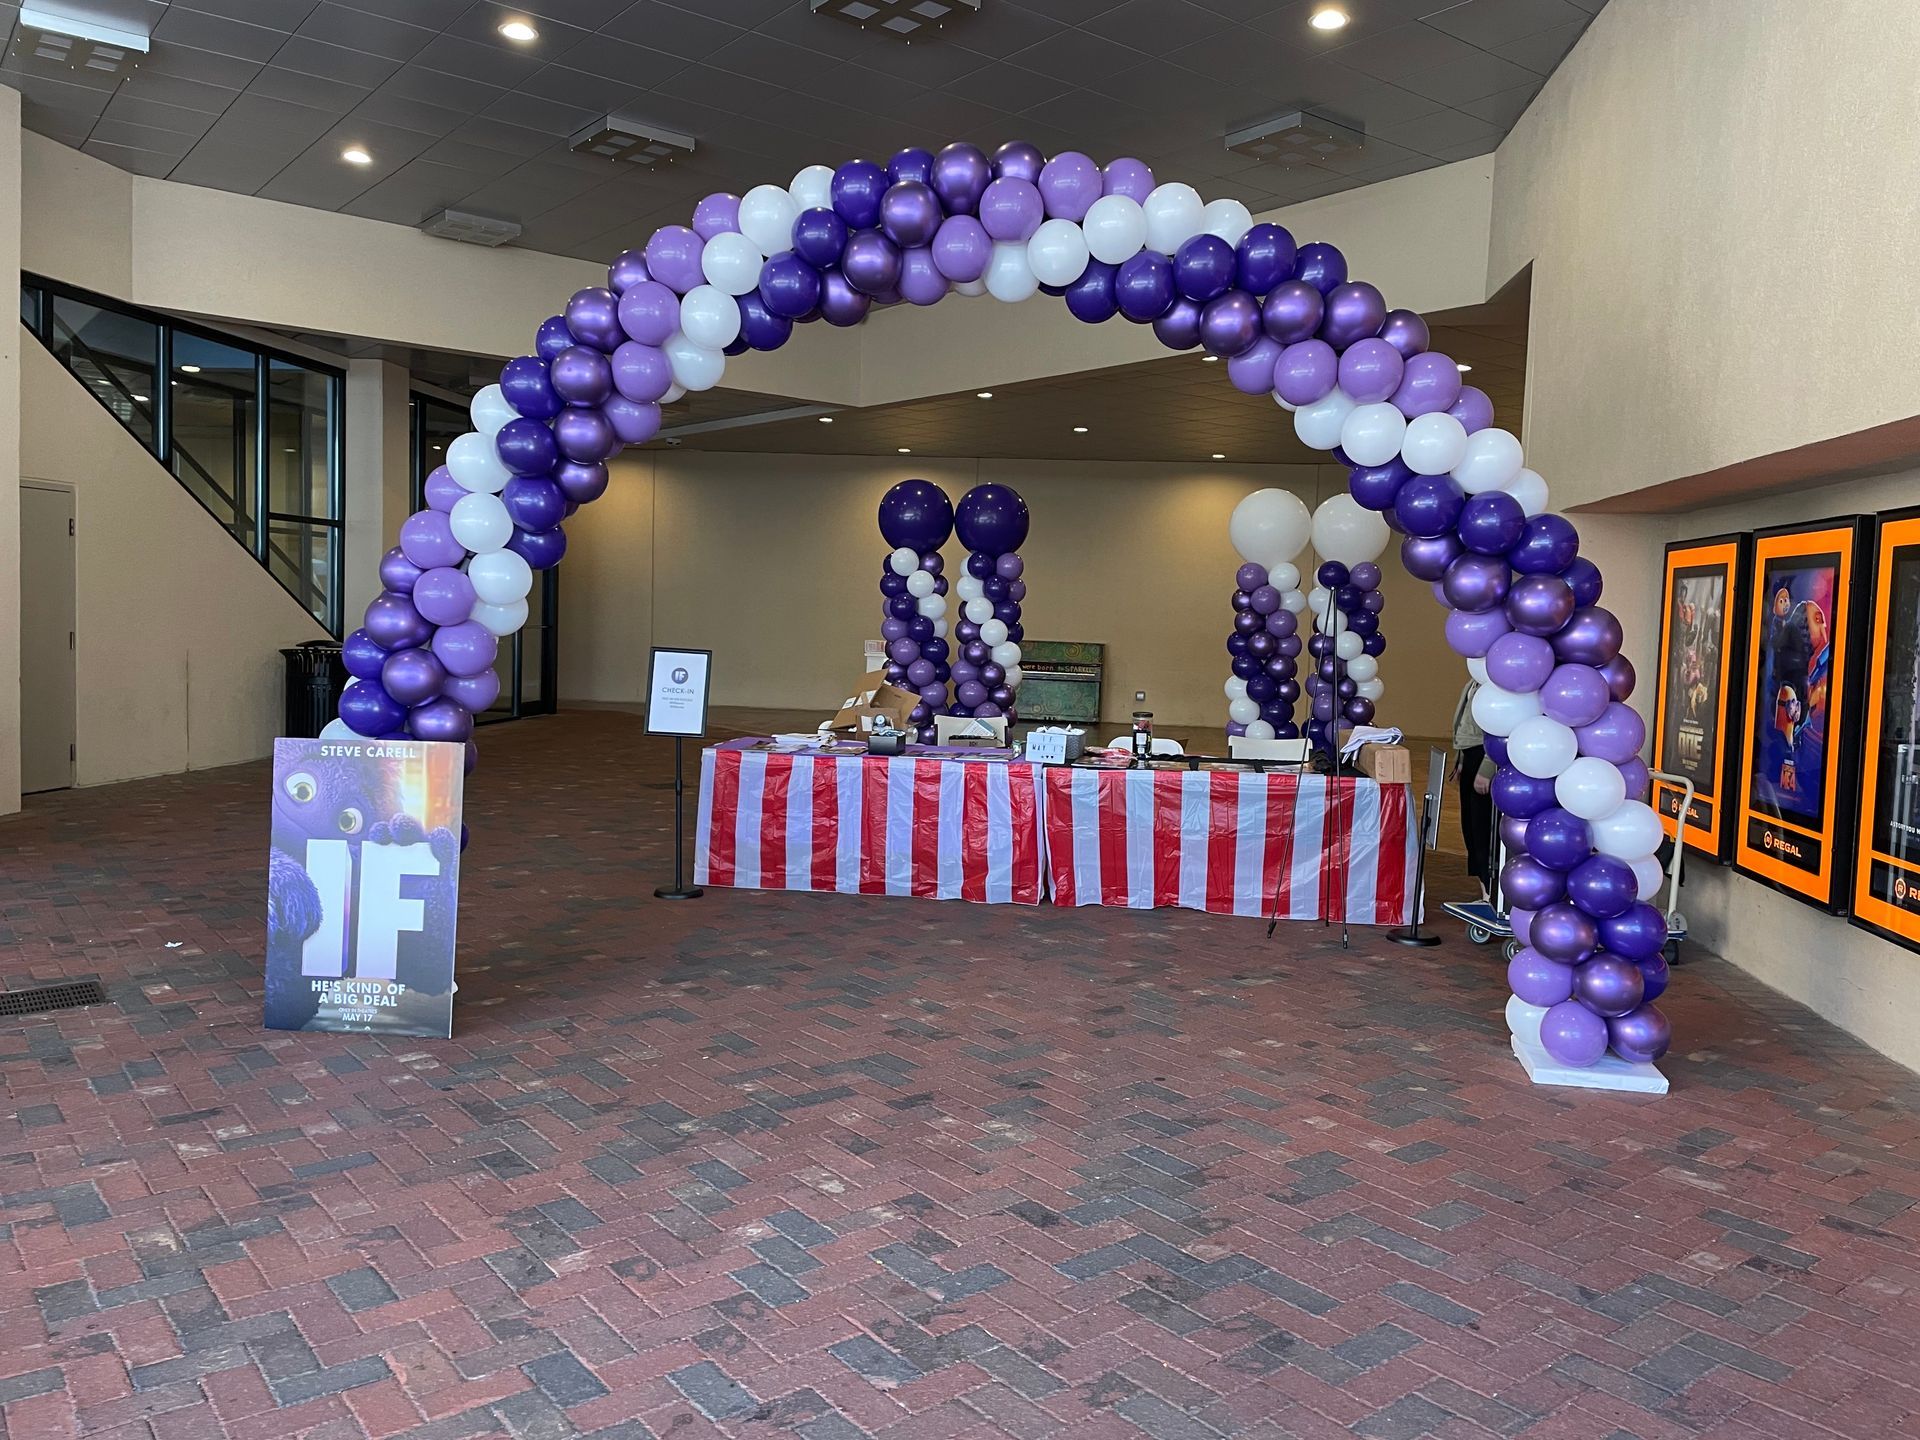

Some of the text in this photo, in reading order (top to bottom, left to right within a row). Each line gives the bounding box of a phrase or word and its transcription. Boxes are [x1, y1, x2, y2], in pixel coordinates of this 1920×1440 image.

[321, 745, 416, 758] STEVE CARELL
[1773, 838, 1802, 857] REGAL
[302, 839, 440, 979] IF
[311, 980, 405, 995] HE'S KIND OF
[318, 993, 397, 1007] A BIG DEAL
[342, 1013, 373, 1022] MAY 17
